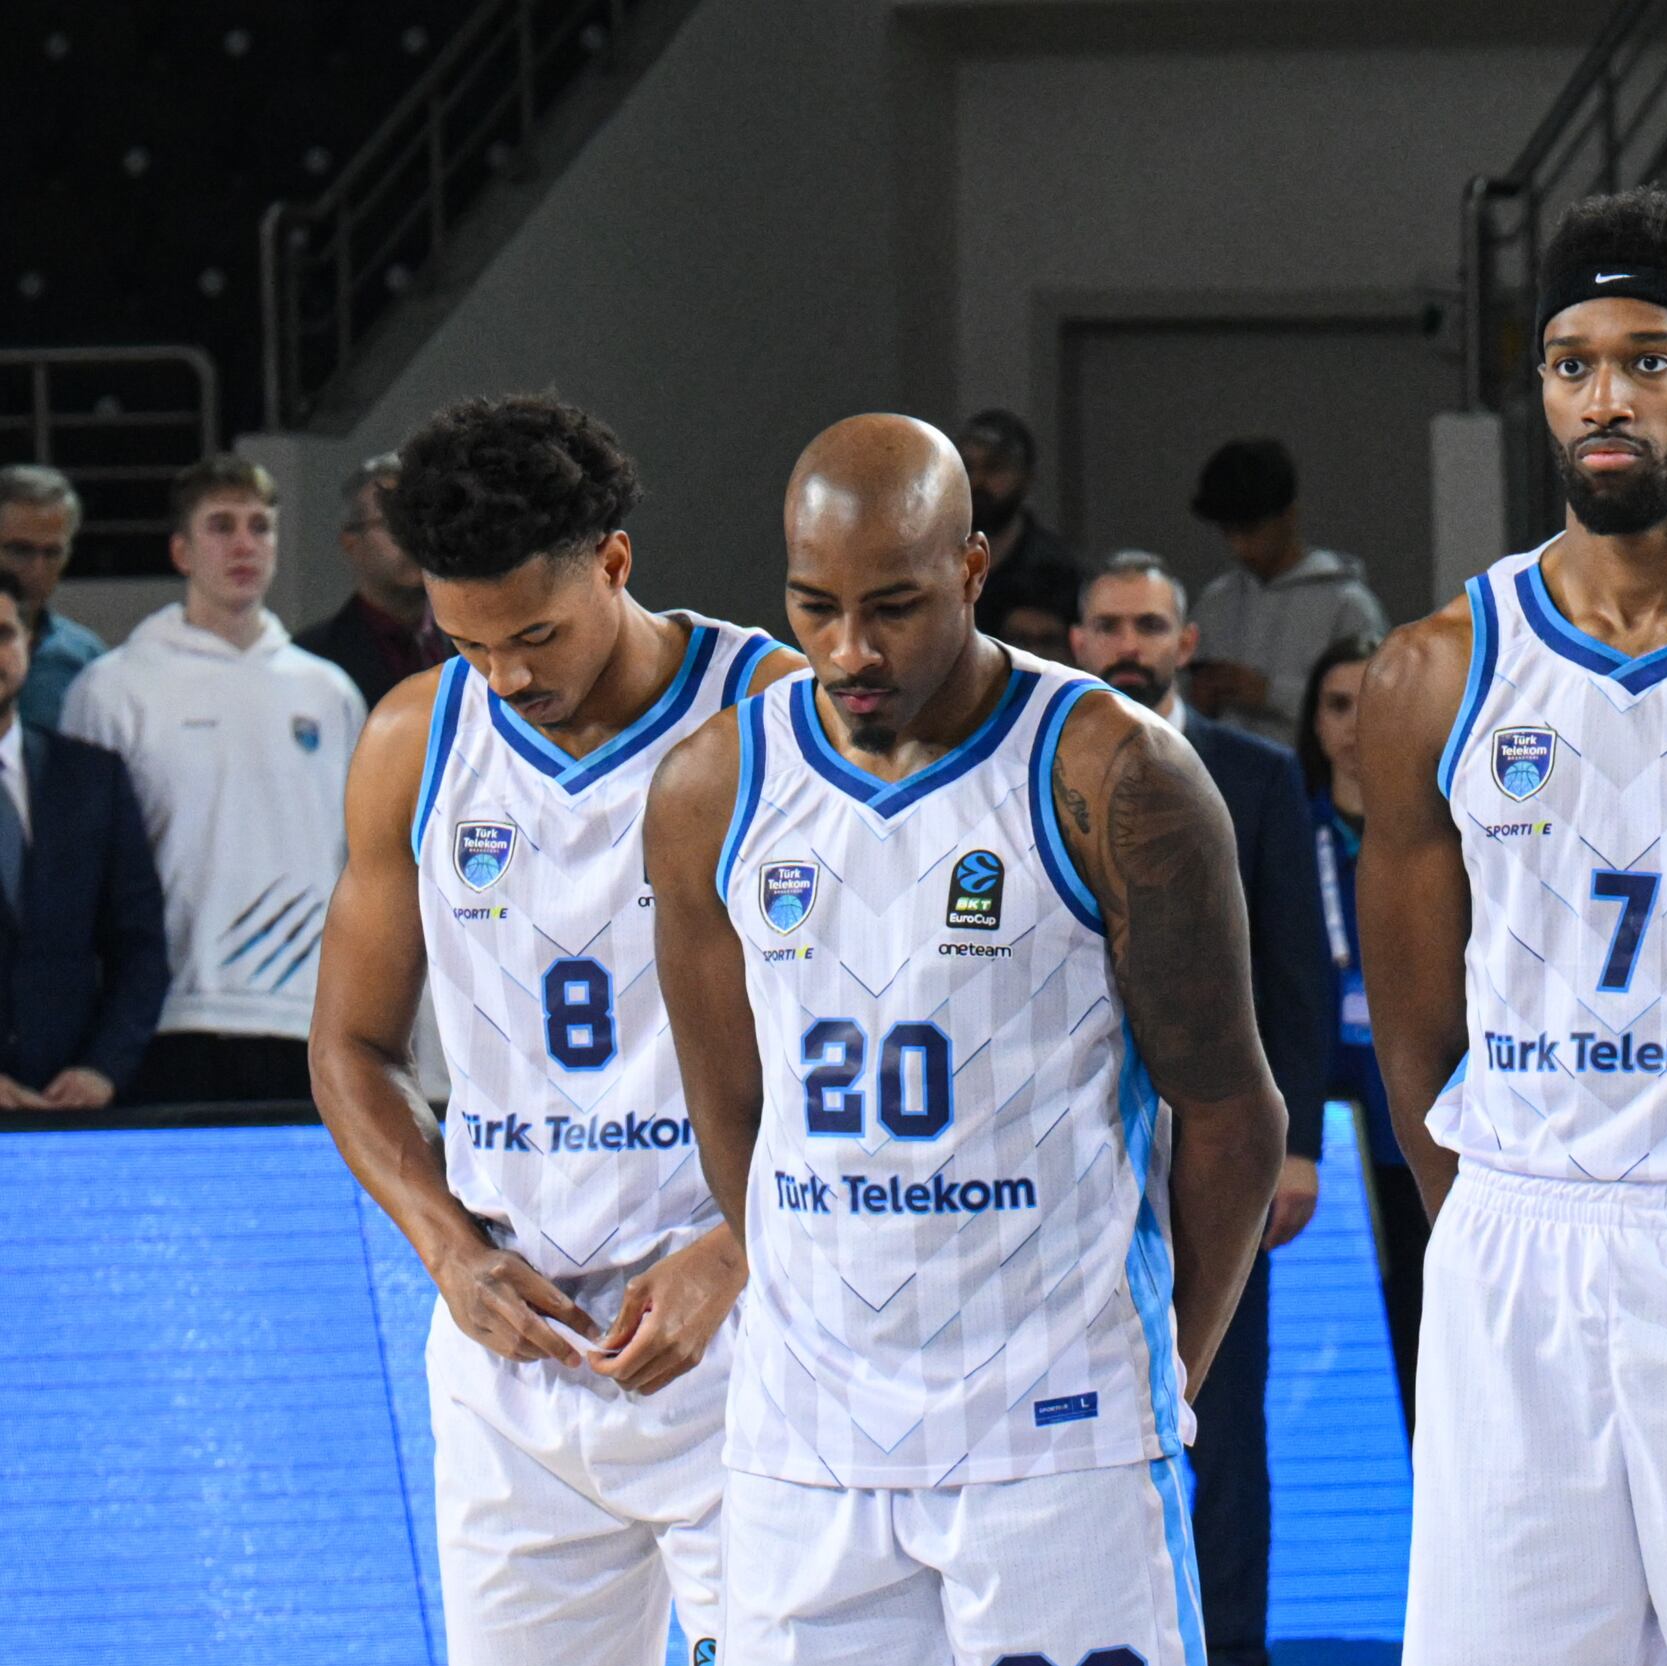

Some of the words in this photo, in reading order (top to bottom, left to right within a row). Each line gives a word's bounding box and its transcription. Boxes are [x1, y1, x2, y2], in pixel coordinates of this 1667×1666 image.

[1512, 734, 1537, 746] Türk
[1501, 744, 1548, 756] Telekom
[474, 827, 498, 838] Türk
[463, 837, 508, 849] Telekom
[778, 868, 801, 880] Türk
[767, 878, 811, 890] Telekom
[955, 896, 992, 911] BKT
[949, 912, 997, 927] EuroCup
[1590, 868, 1663, 994] 7
[938, 943, 1013, 959] oneteam
[541, 956, 618, 1073] 8
[1485, 1031, 1561, 1073] Türk
[800, 1017, 955, 1142] 20
[462, 1112, 532, 1152] ürk
[544, 1110, 692, 1153] Teleko
[774, 1170, 832, 1214] Türk
[840, 1173, 1038, 1215] Telekom
